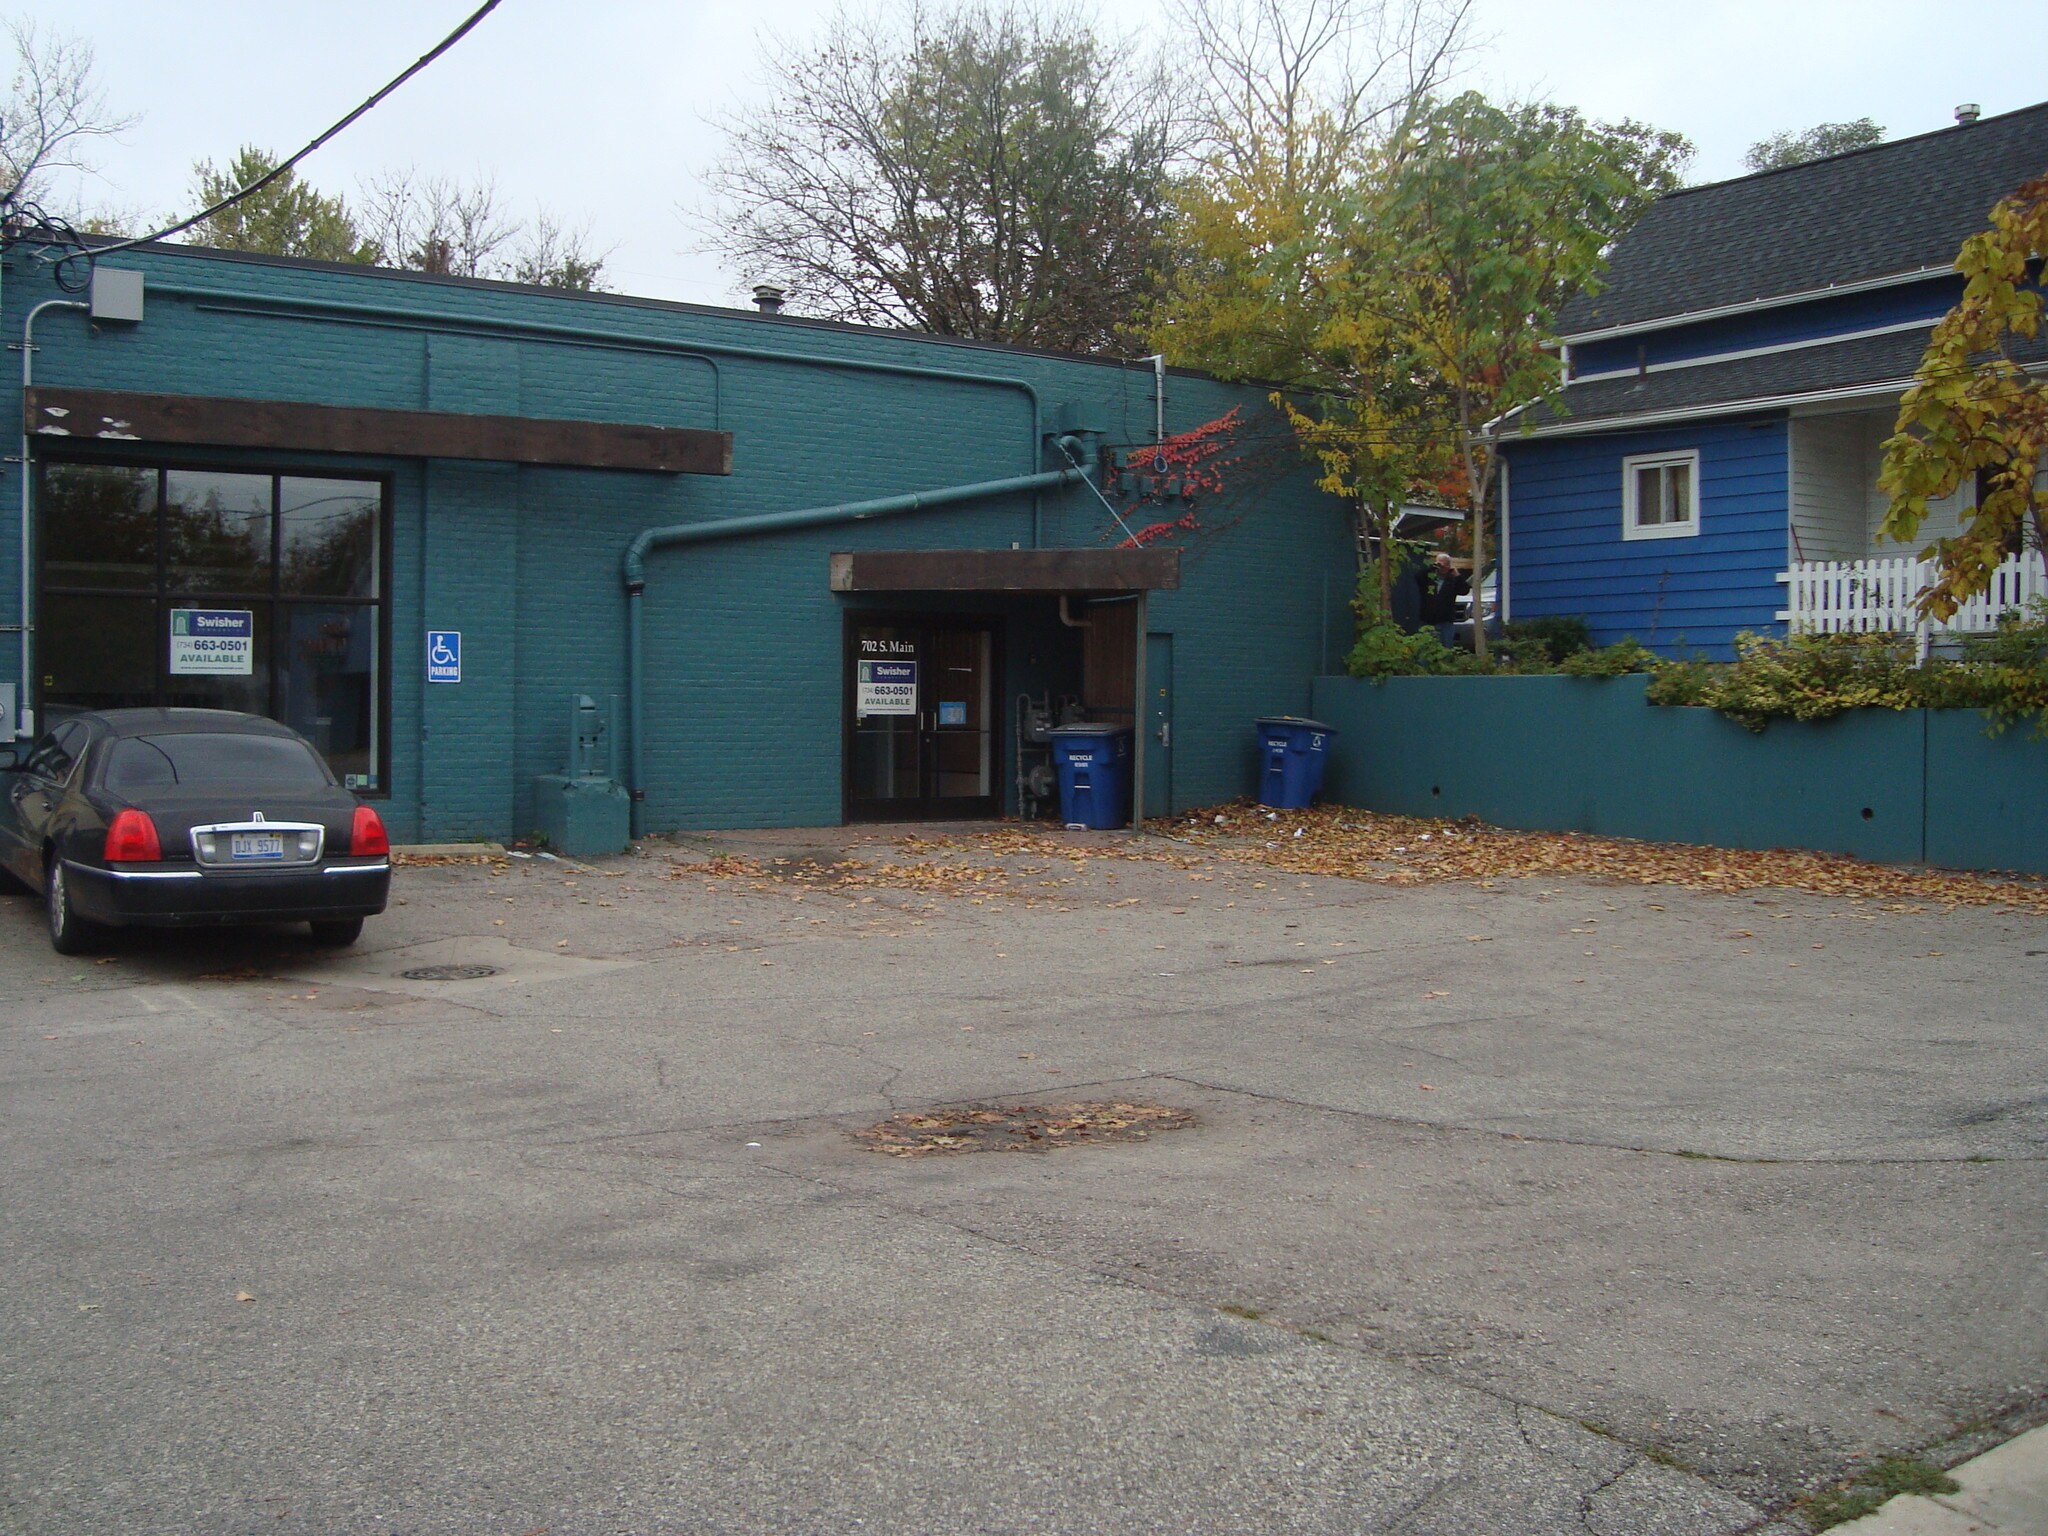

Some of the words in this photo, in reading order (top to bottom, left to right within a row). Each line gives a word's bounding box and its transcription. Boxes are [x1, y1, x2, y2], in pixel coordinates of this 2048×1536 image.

[197, 616, 244, 628] Swisher
[194, 640, 248, 651] 663-0501
[861, 640, 878, 652] 702
[879, 640, 888, 652] S.
[889, 641, 915, 653] Main
[180, 654, 245, 663] AVAILABLE
[431, 666, 458, 676] PARKING
[876, 666, 911, 676] Swisher
[874, 686, 913, 695] 663-0501
[257, 839, 280, 852] 9577
